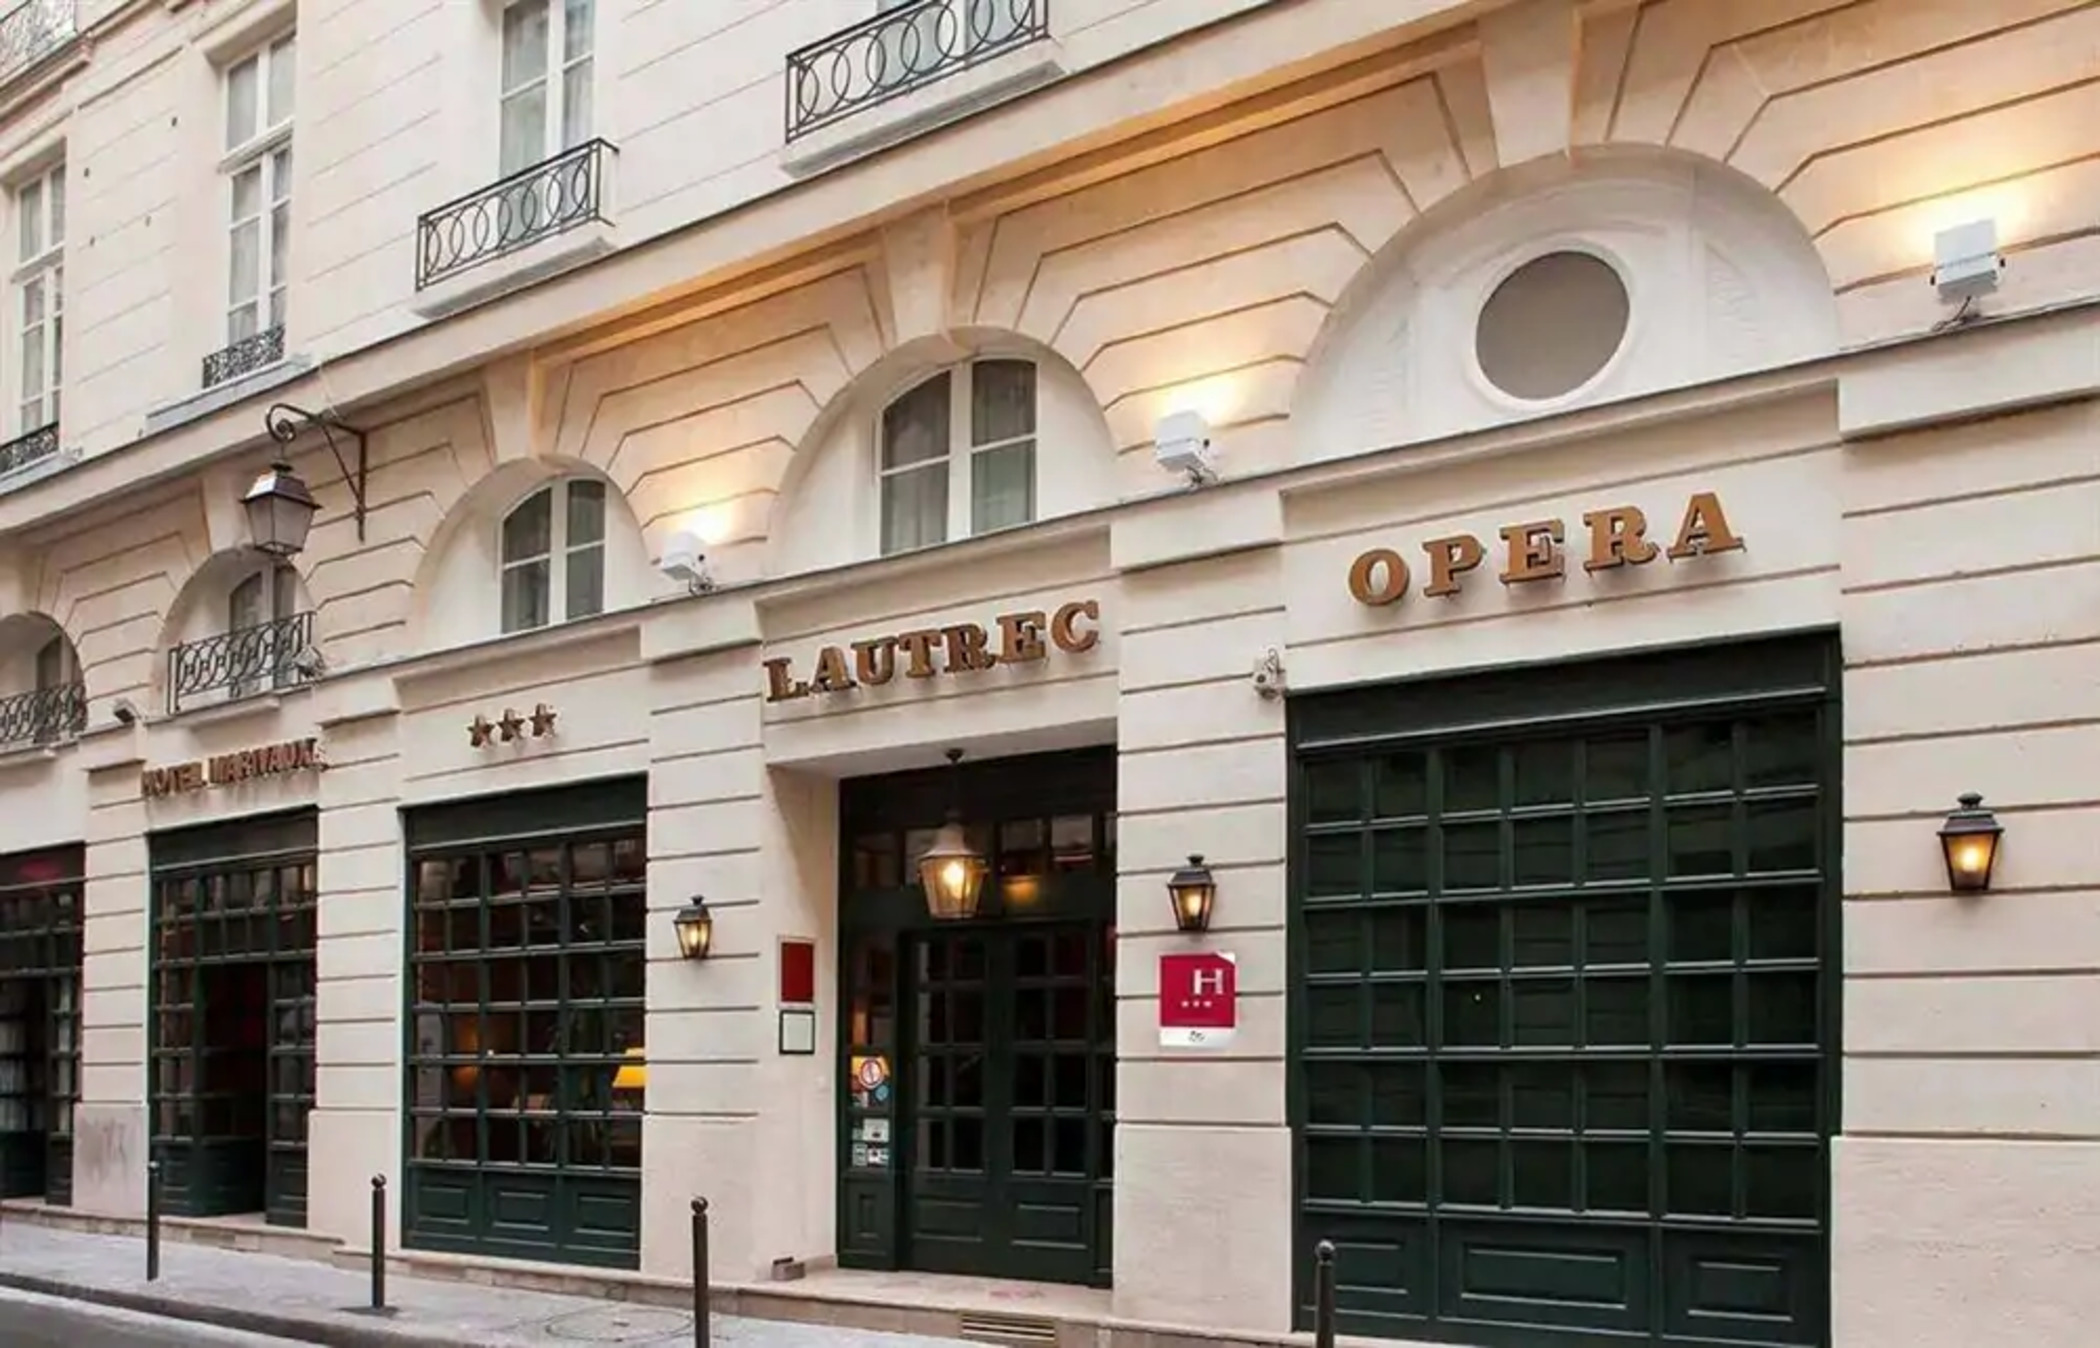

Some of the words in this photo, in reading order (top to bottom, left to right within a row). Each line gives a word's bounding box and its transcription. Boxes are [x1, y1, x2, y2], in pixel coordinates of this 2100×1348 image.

[1348, 491, 1745, 606] OPERA
[763, 599, 1100, 702] LAUTREC
[1193, 968, 1223, 995] H
